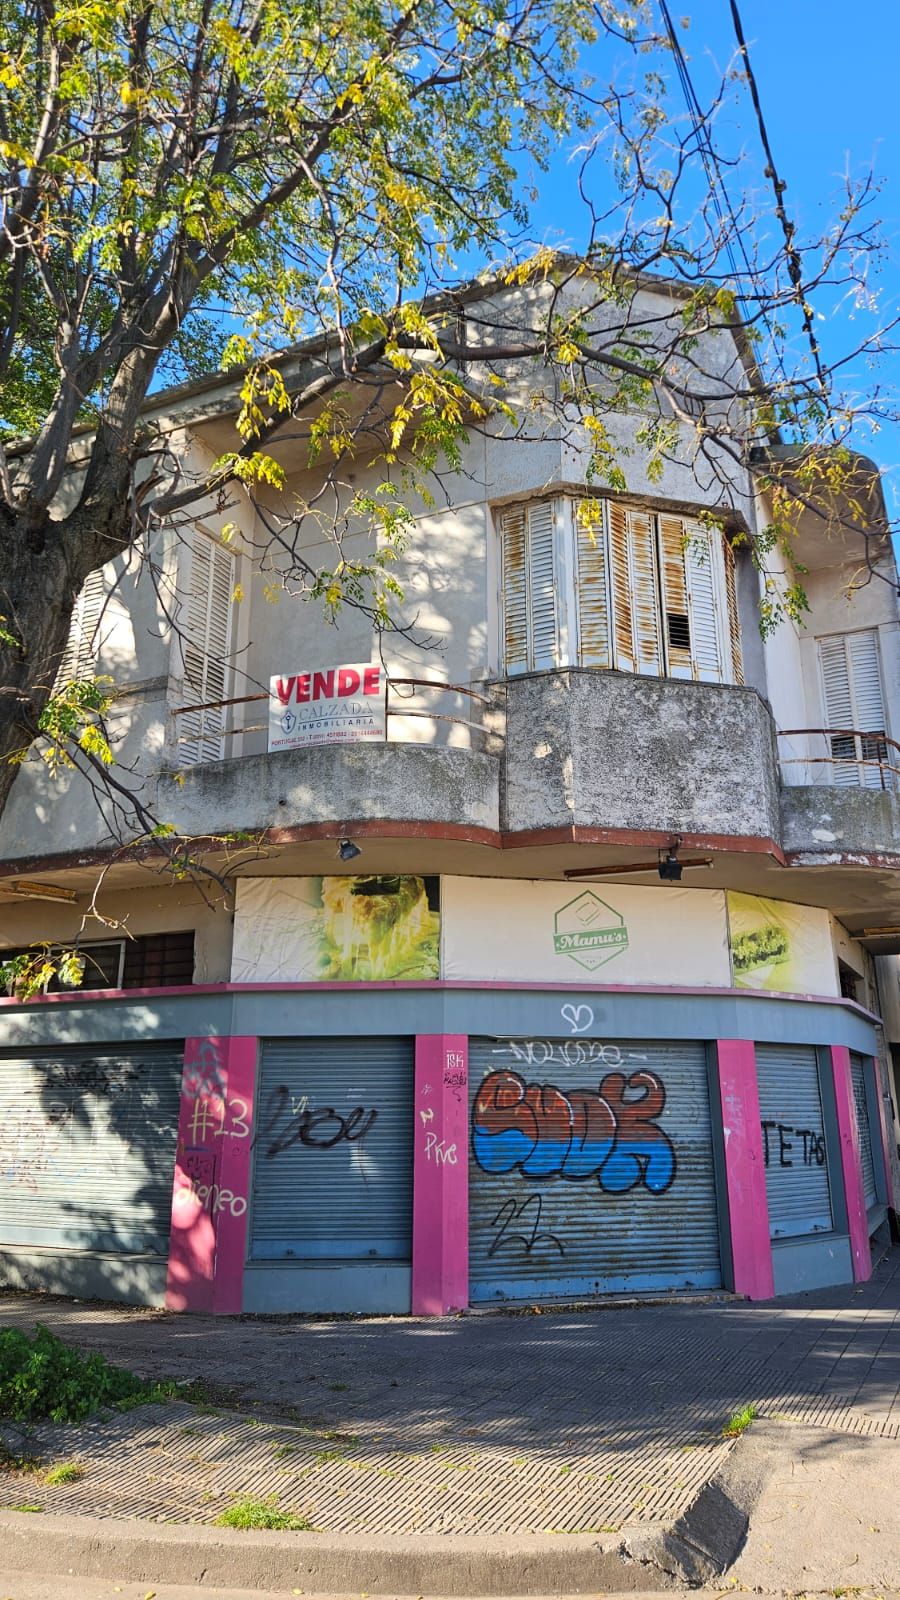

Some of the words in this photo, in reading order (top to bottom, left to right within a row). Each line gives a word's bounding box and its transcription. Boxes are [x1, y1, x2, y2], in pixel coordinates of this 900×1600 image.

[276, 667, 381, 706] VENDE
[299, 702, 374, 720] CALZADA
[298, 719, 374, 731] INMOBILIARIA
[560, 933, 622, 949] Mamu's
[760, 1120, 825, 1168] TETAS
